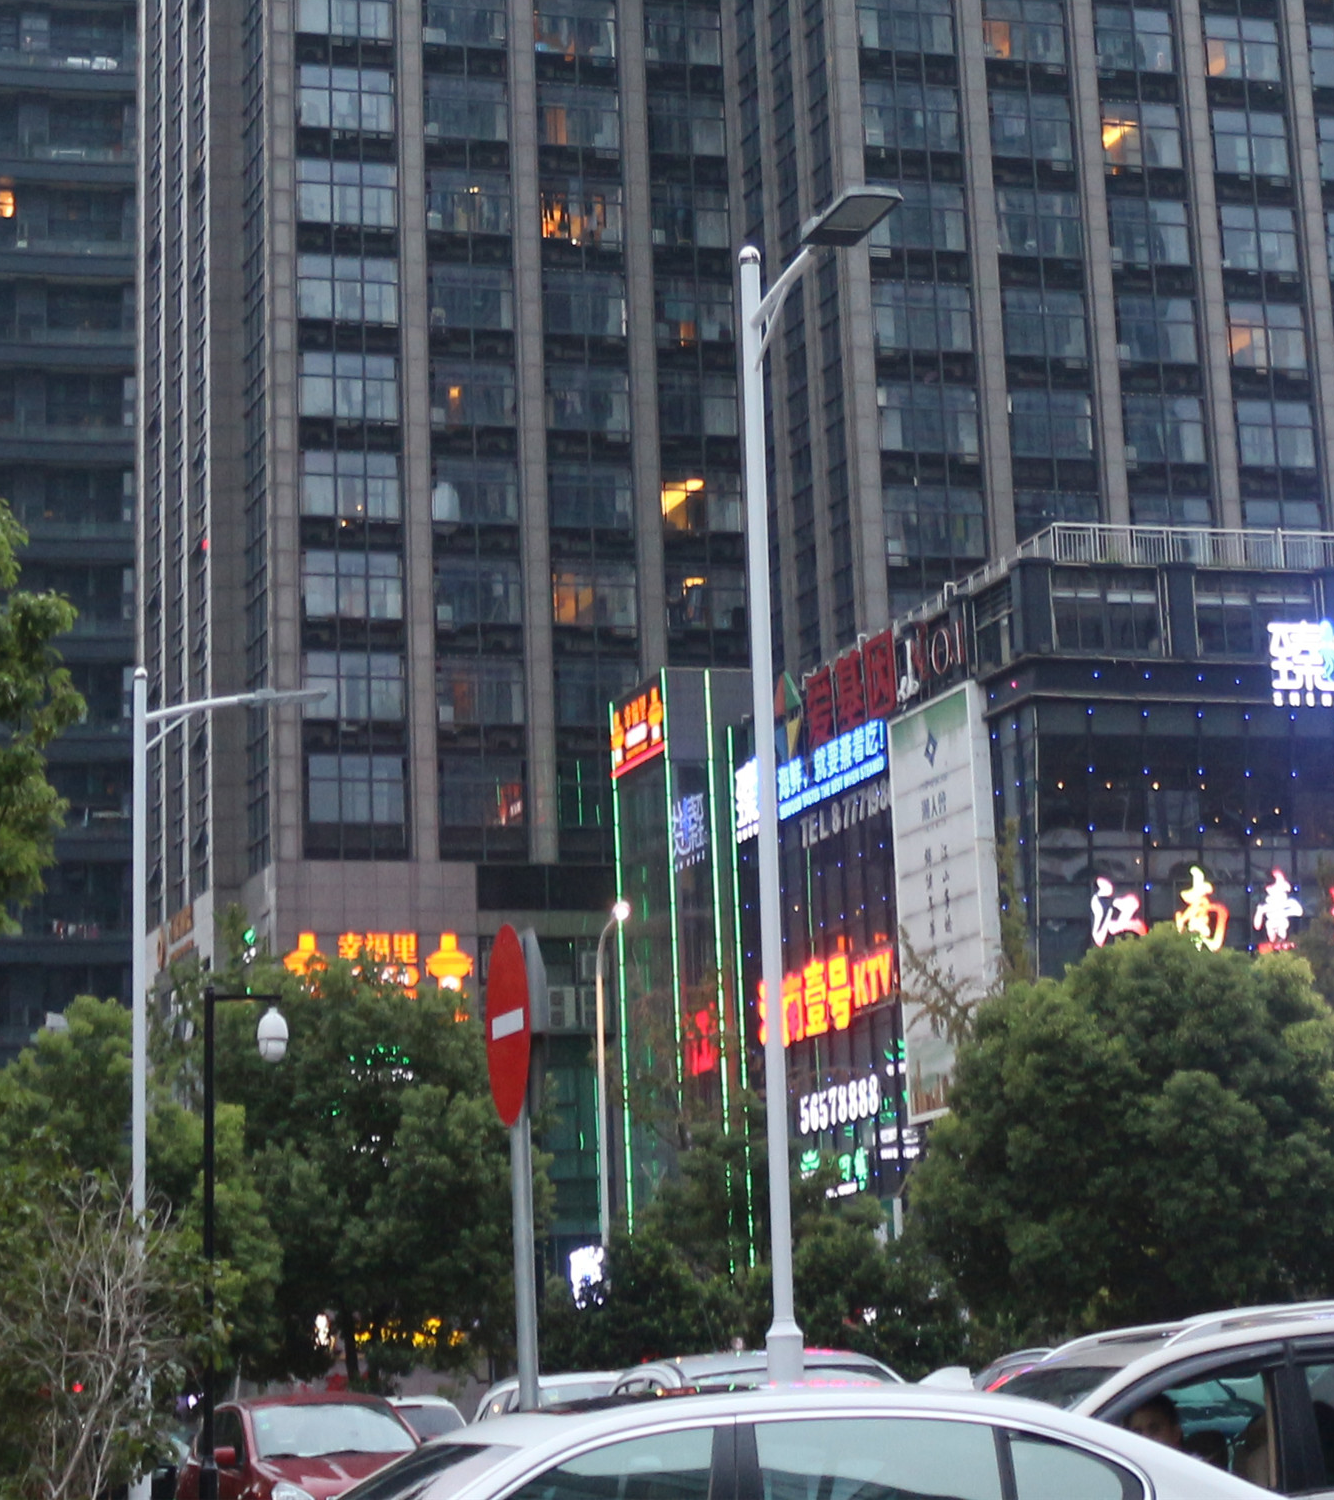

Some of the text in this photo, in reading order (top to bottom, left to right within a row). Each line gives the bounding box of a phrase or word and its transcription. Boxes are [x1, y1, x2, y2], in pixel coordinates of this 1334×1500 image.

[805, 630, 897, 747] 爱基因
[799, 809, 829, 850] TEL
[799, 1073, 880, 1135] 56578888
